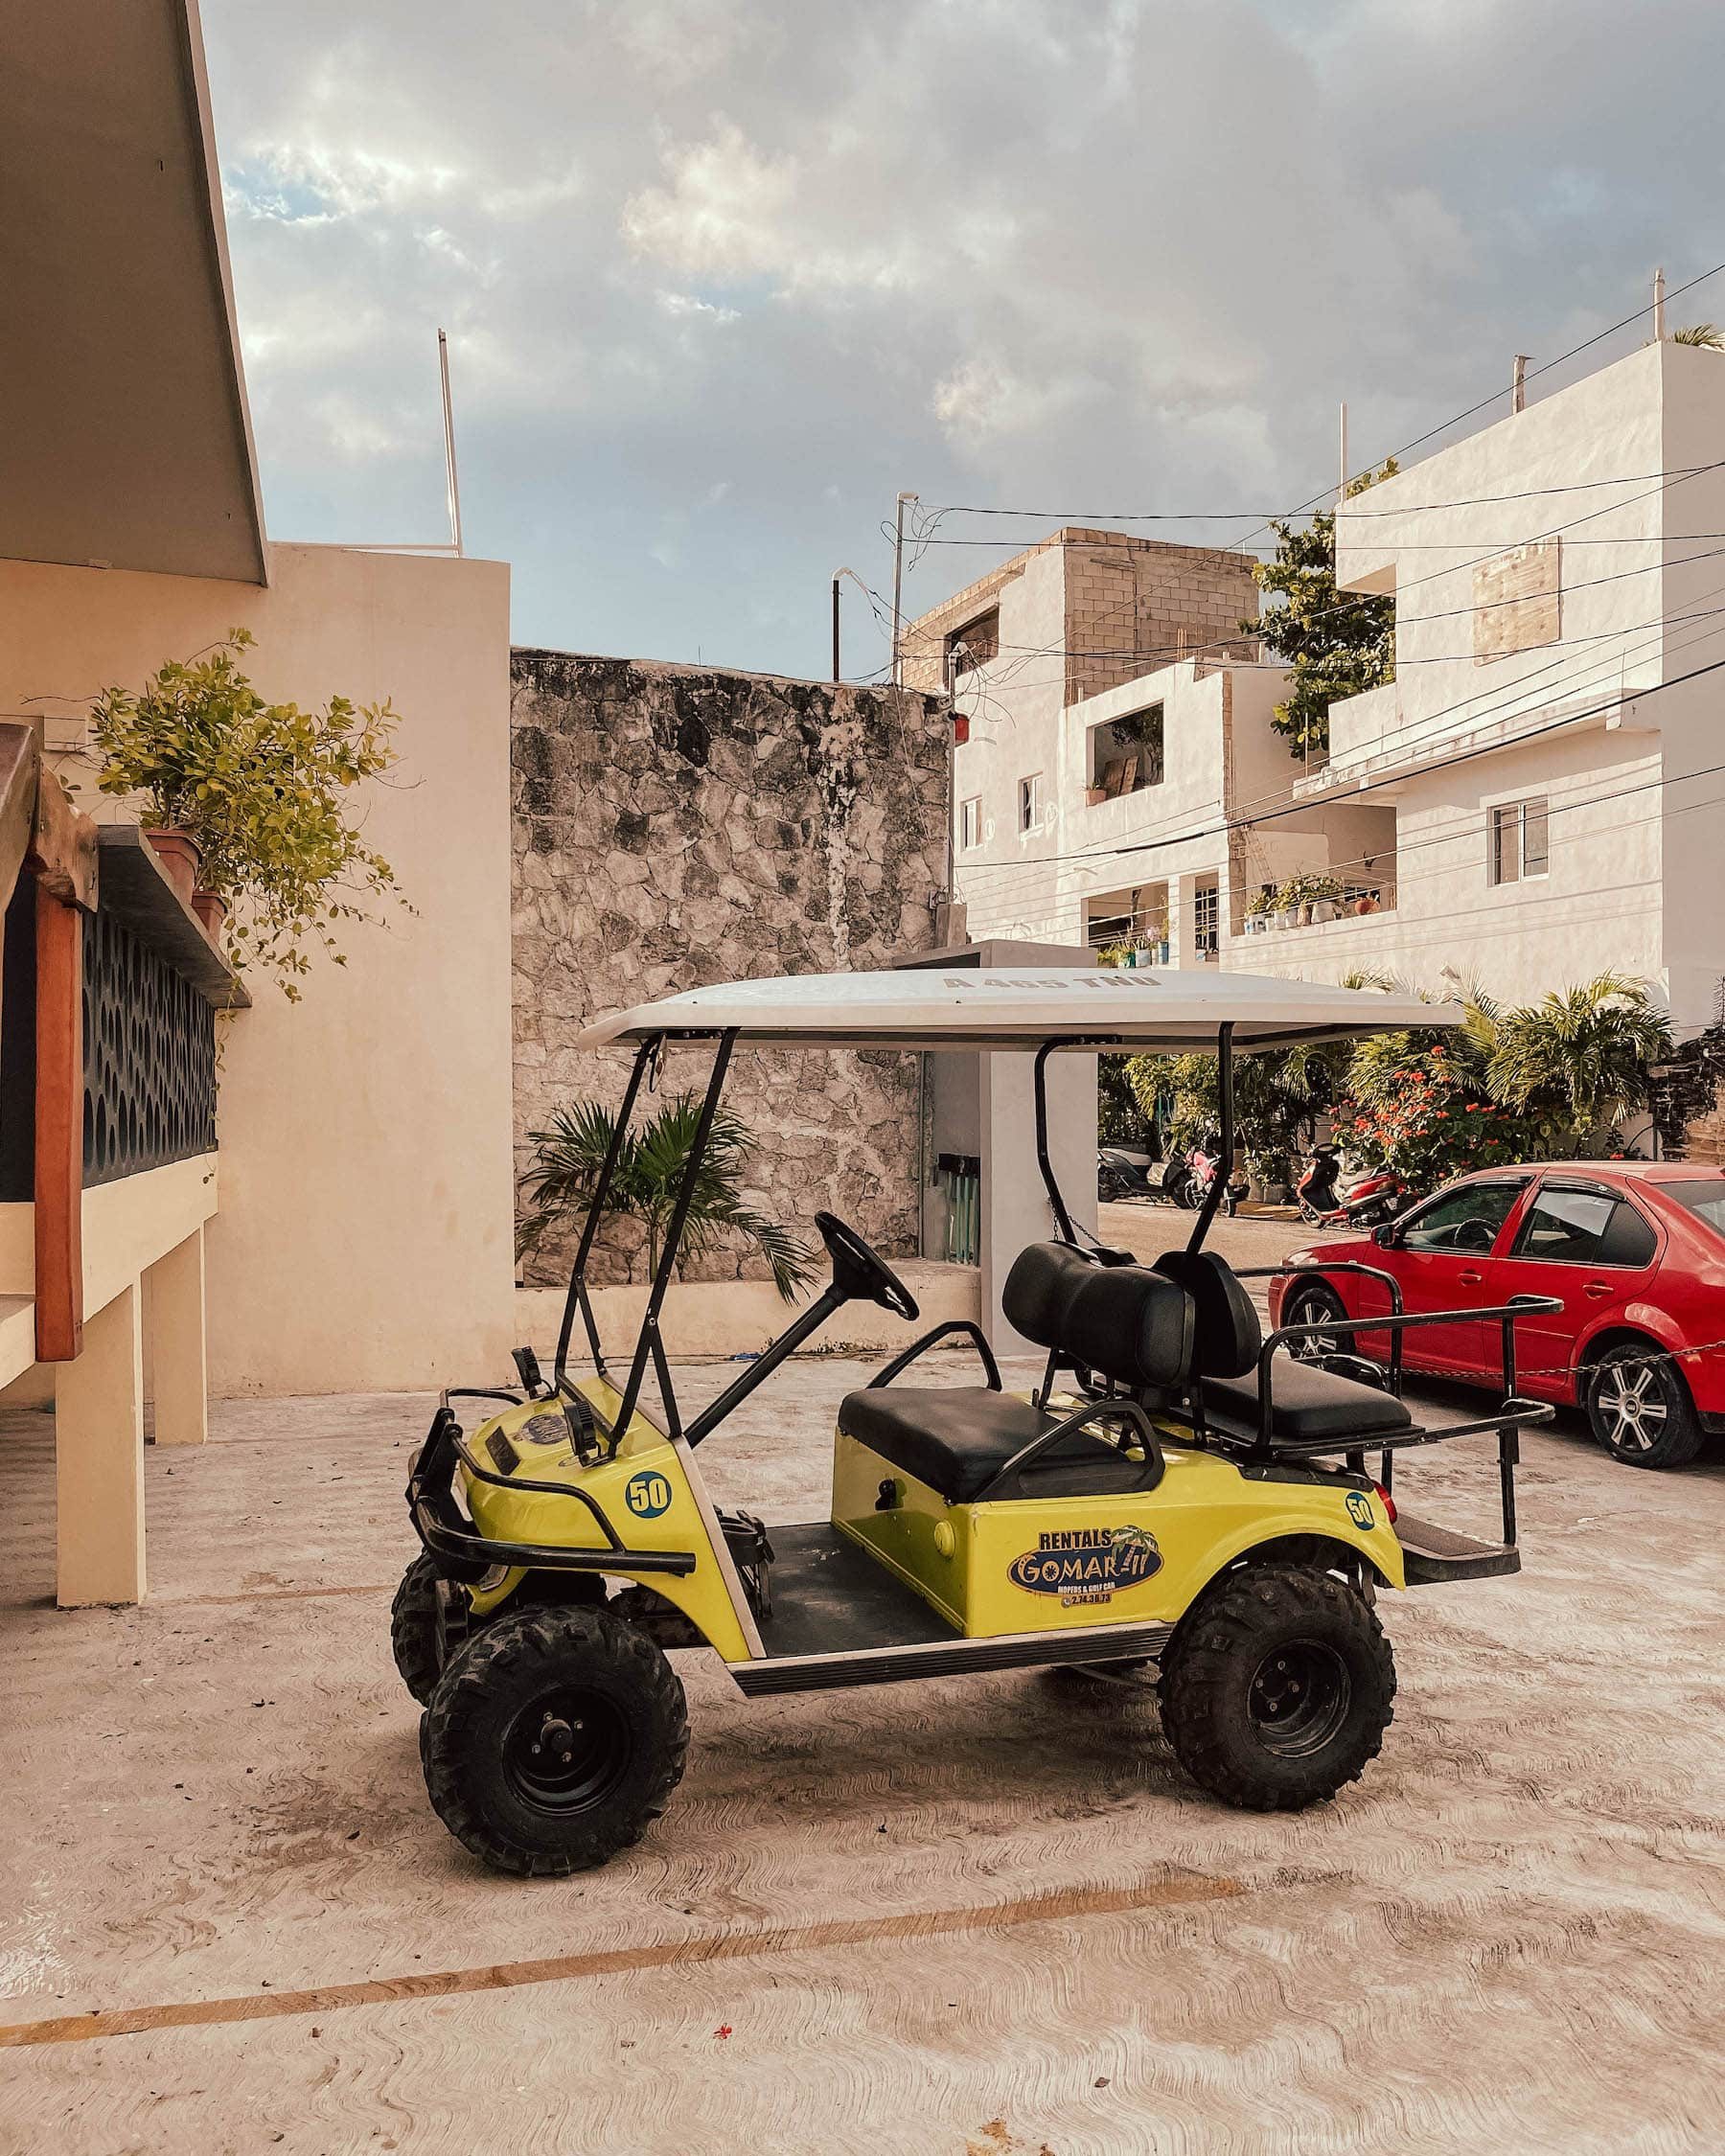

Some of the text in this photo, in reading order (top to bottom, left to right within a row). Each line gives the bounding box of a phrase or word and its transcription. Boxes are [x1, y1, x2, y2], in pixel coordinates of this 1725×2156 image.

[943, 978, 976, 989] A
[629, 1479, 668, 1511] 50
[1346, 1499, 1373, 1525] 50
[1040, 1529, 1113, 1550] RENTALS
